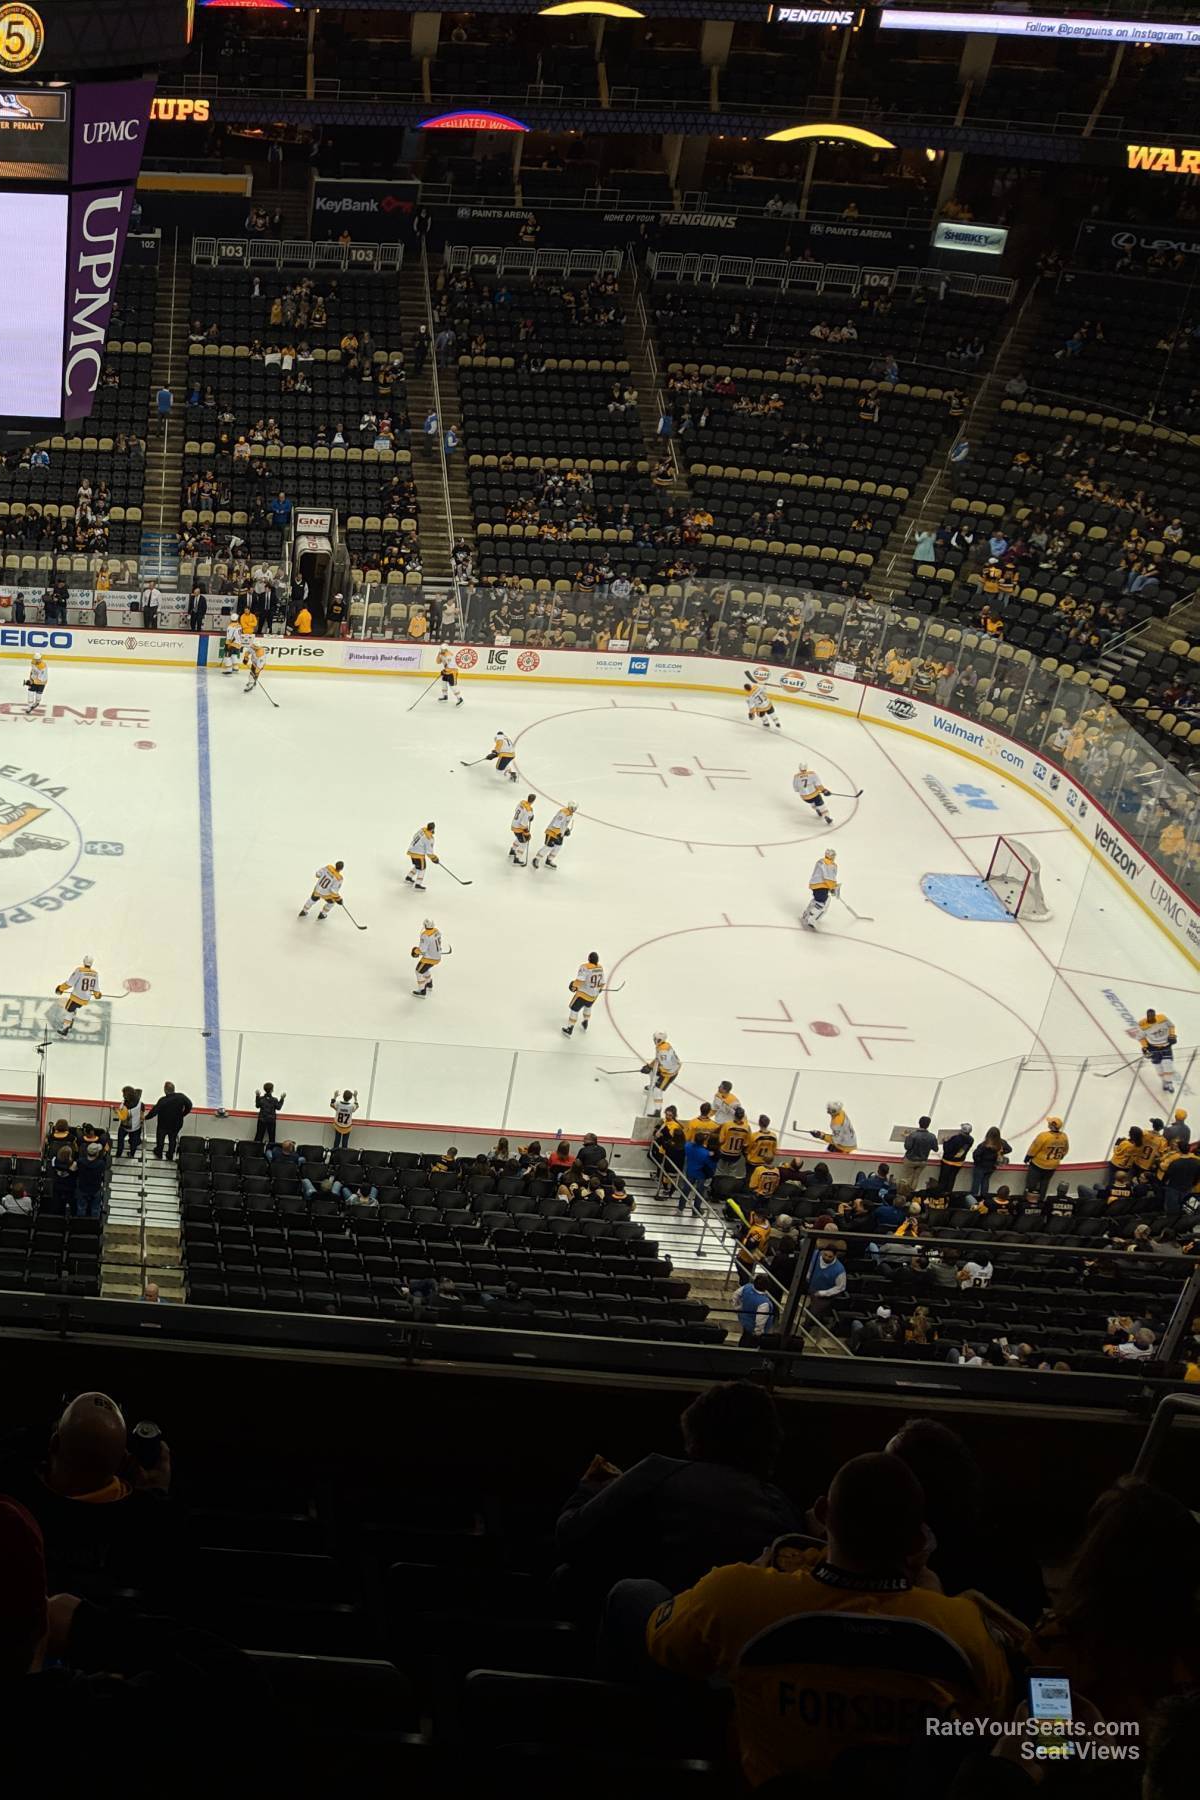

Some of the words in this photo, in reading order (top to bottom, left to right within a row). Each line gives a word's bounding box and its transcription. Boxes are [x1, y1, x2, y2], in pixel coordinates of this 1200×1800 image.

[778, 7, 854, 25] PENGUINS
[5, 21, 26, 54] 5
[1025, 21, 1056, 34] Follow
[1057, 23, 1113, 37] @penguins
[1115, 29, 1129, 38] on
[1131, 28, 1183, 41] Instagram
[13, 121, 45, 131] PENALTY
[83, 119, 139, 145] UPMC
[316, 196, 378, 214] KeyBank
[471, 209, 503, 220] PAINTS
[603, 213, 623, 222] HOME
[625, 214, 634, 222] OF
[635, 215, 656, 223] YOUR
[658, 212, 738, 230] PENGUINS
[825, 225, 858, 237] PAINTS
[860, 228, 893, 240] ARENA
[944, 230, 990, 245] SHORKEY
[141, 240, 156, 249] 102
[221, 245, 243, 258] 103
[351, 249, 373, 262] 103
[473, 253, 497, 266] 104
[864, 273, 889, 287] 104
[65, 191, 122, 398] UPMC
[298, 517, 329, 526] GNC
[87, 638, 124, 647] VECTOR
[487, 649, 508, 665] IC
[631, 661, 647, 671] IGS
[754, 670, 770, 678] Gulf
[780, 676, 806, 689] Gulf
[817, 682, 834, 691] Gulf
[887, 699, 918, 717] NHL
[75, 719, 150, 729] WELL
[933, 714, 985, 748] Walmart
[85, 842, 124, 856] PPG
[1095, 823, 1138, 881] verizon
[318, 874, 332, 890] 10
[30, 876, 97, 912] PPG
[1150, 878, 1187, 928] UPMC
[1101, 988, 1140, 1028] VECTOR
[337, 1112, 350, 1124] 87
[729, 1137, 744, 1151] 10
